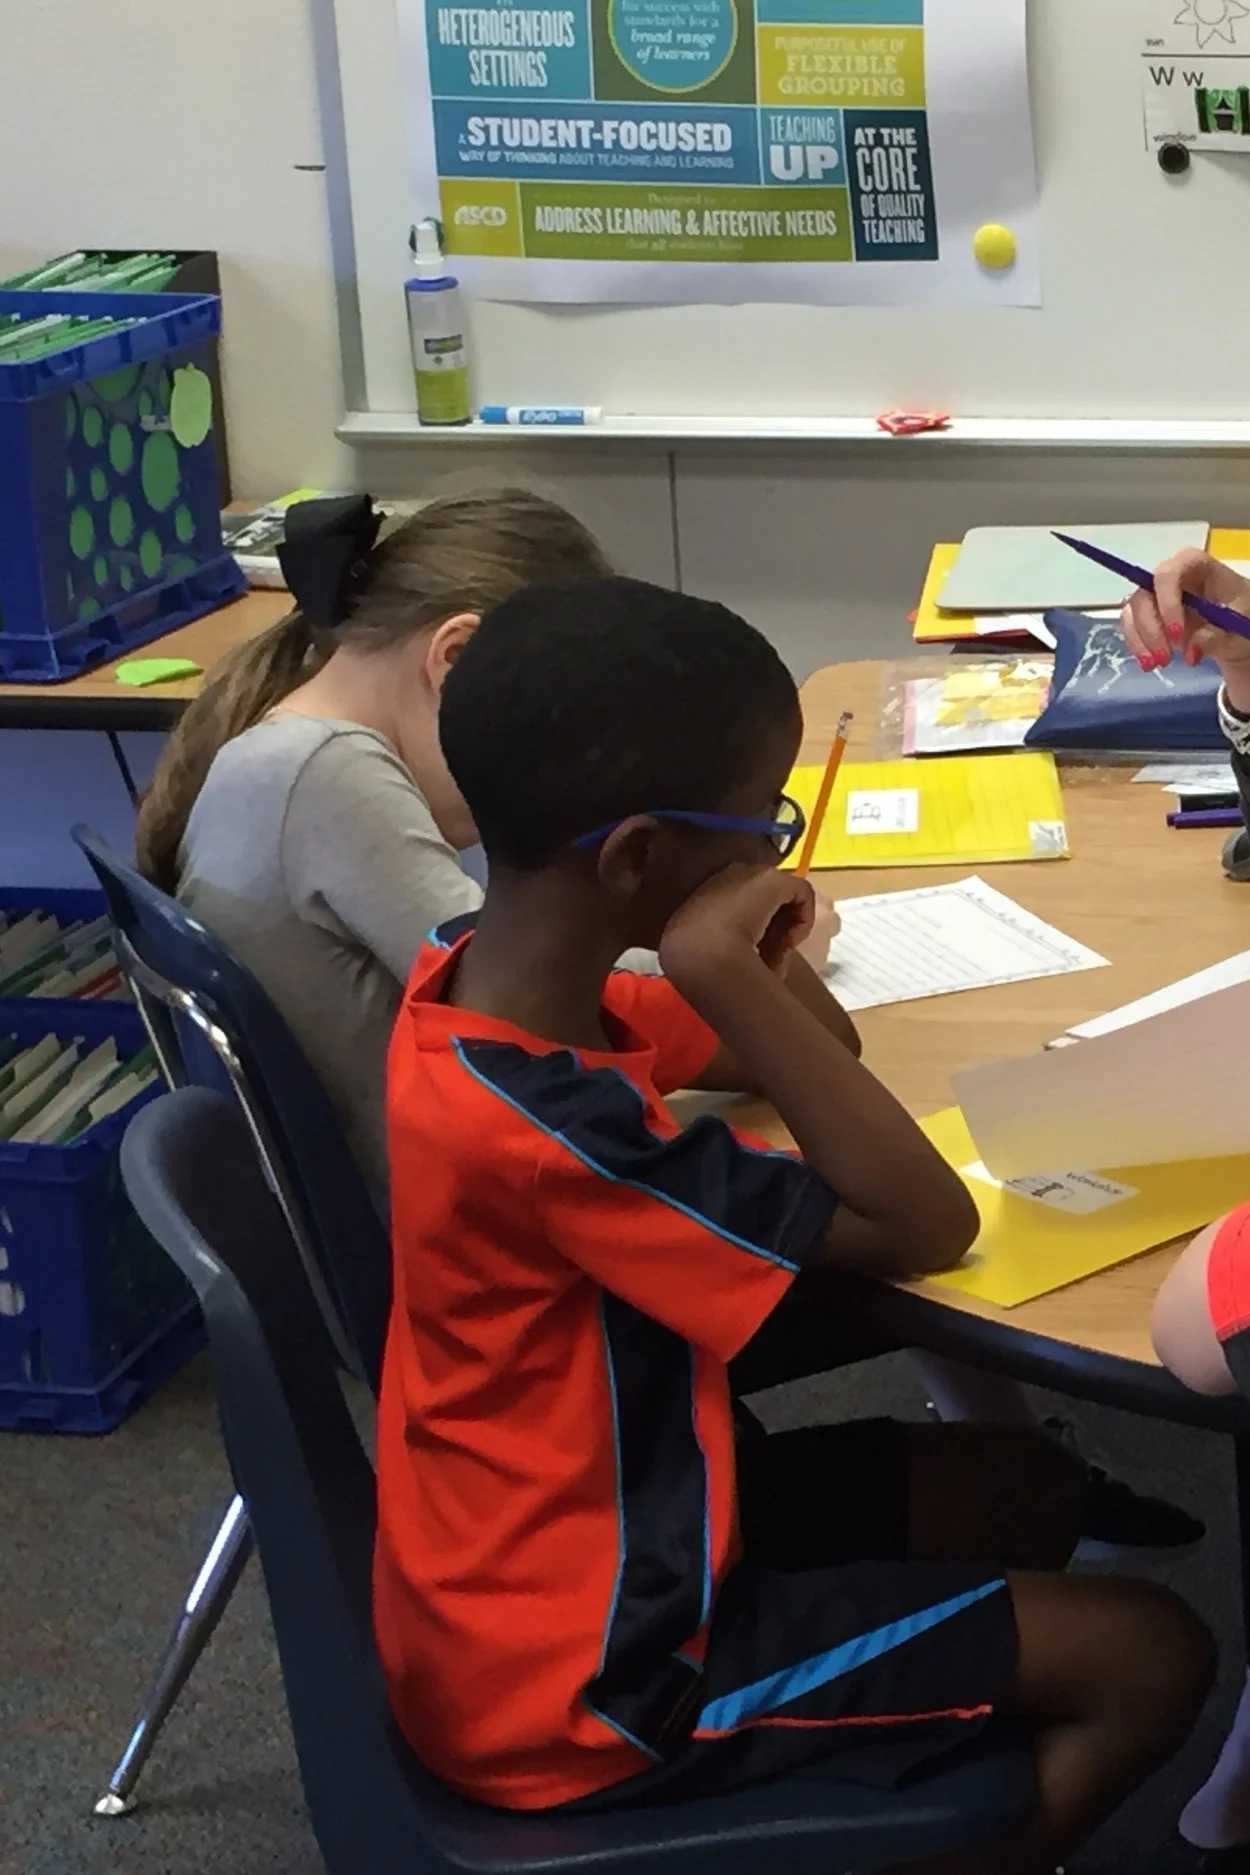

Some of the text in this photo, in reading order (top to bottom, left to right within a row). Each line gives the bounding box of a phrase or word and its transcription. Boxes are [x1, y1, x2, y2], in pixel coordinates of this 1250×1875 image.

[438, 8, 575, 48] HETEROGENEOUS
[630, 28, 717, 49] broad range
[636, 45, 710, 64] of learners
[774, 36, 859, 52] PURPOSEFUL
[890, 38, 908, 53] OF
[468, 49, 549, 88] SETTINGS
[786, 54, 897, 75] FLEXIBLE
[1149, 66, 1204, 87] W w
[778, 76, 905, 97] GROUPING
[467, 116, 732, 152] STUDENT-FOCUSED
[770, 115, 836, 143] TEACHING
[854, 127, 917, 146] AT THE
[458, 151, 734, 169] WAY OF THINKING ABOUT TEACHING AND LEARNING
[769, 145, 839, 181] UP
[856, 147, 921, 192] CORE
[860, 193, 925, 218] OF QUALITY
[535, 206, 837, 237] ADDRESS LEARNING & AFFECTIVE NEEDS
[862, 218, 925, 244] TEACHING
